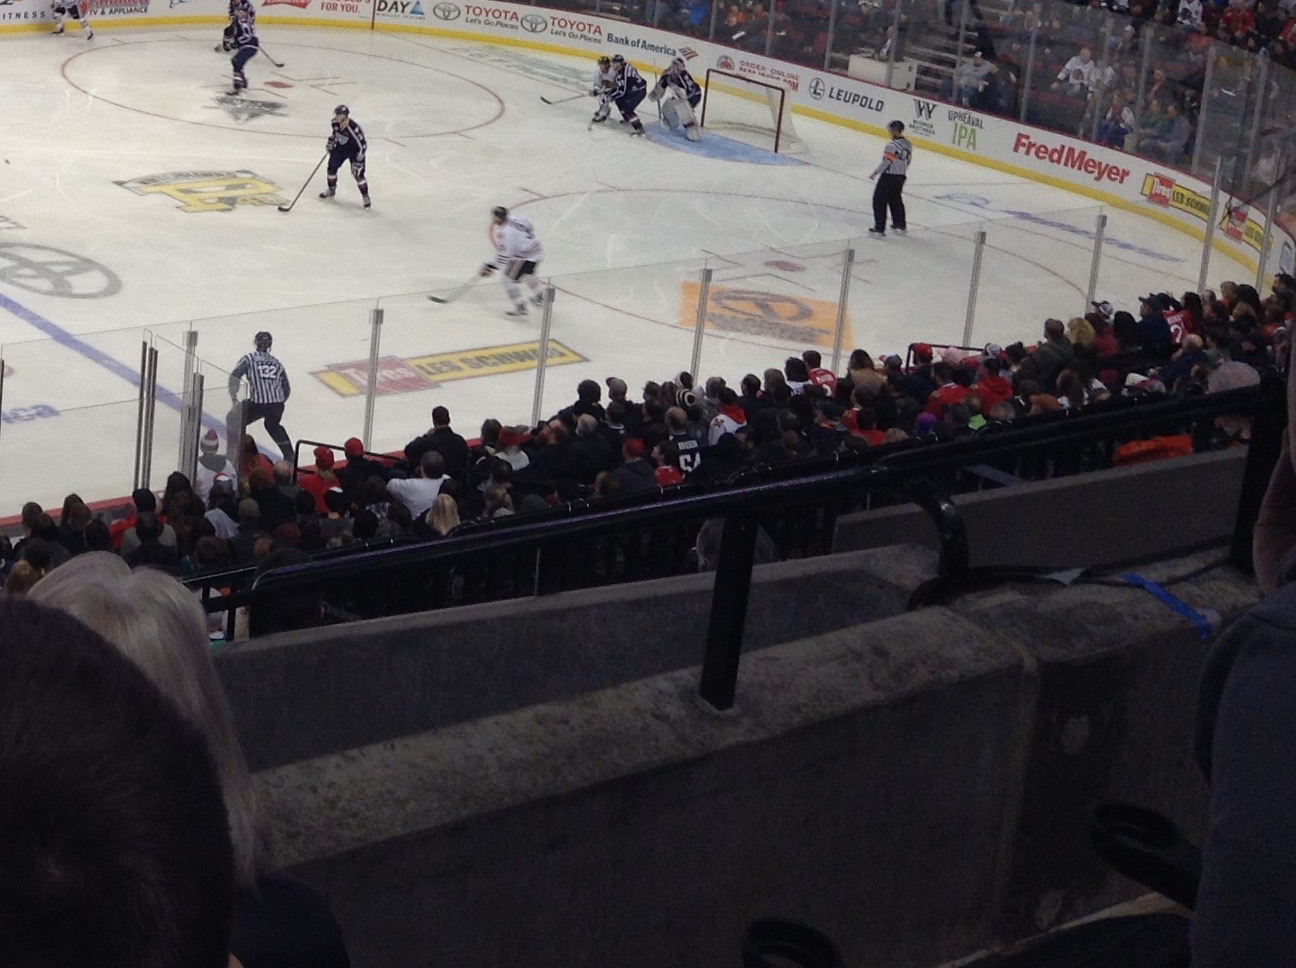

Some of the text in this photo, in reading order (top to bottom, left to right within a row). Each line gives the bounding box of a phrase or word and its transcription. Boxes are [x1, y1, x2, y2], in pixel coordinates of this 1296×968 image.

[321, 2, 360, 14] FOR YOU.
[376, 0, 411, 13] DAY
[464, 4, 519, 22] TOYOTA
[465, 16, 519, 31] Let's Go Places
[550, 16, 603, 36] TOYOTA
[550, 28, 602, 44] Let's Go Places
[606, 32, 677, 57] Bank of America
[828, 86, 885, 112] LEUPOLD
[947, 109, 983, 130] UPHEAVAL
[951, 122, 977, 150] IPA
[1013, 132, 1131, 184] FredMeyer
[257, 364, 277, 378] 132
